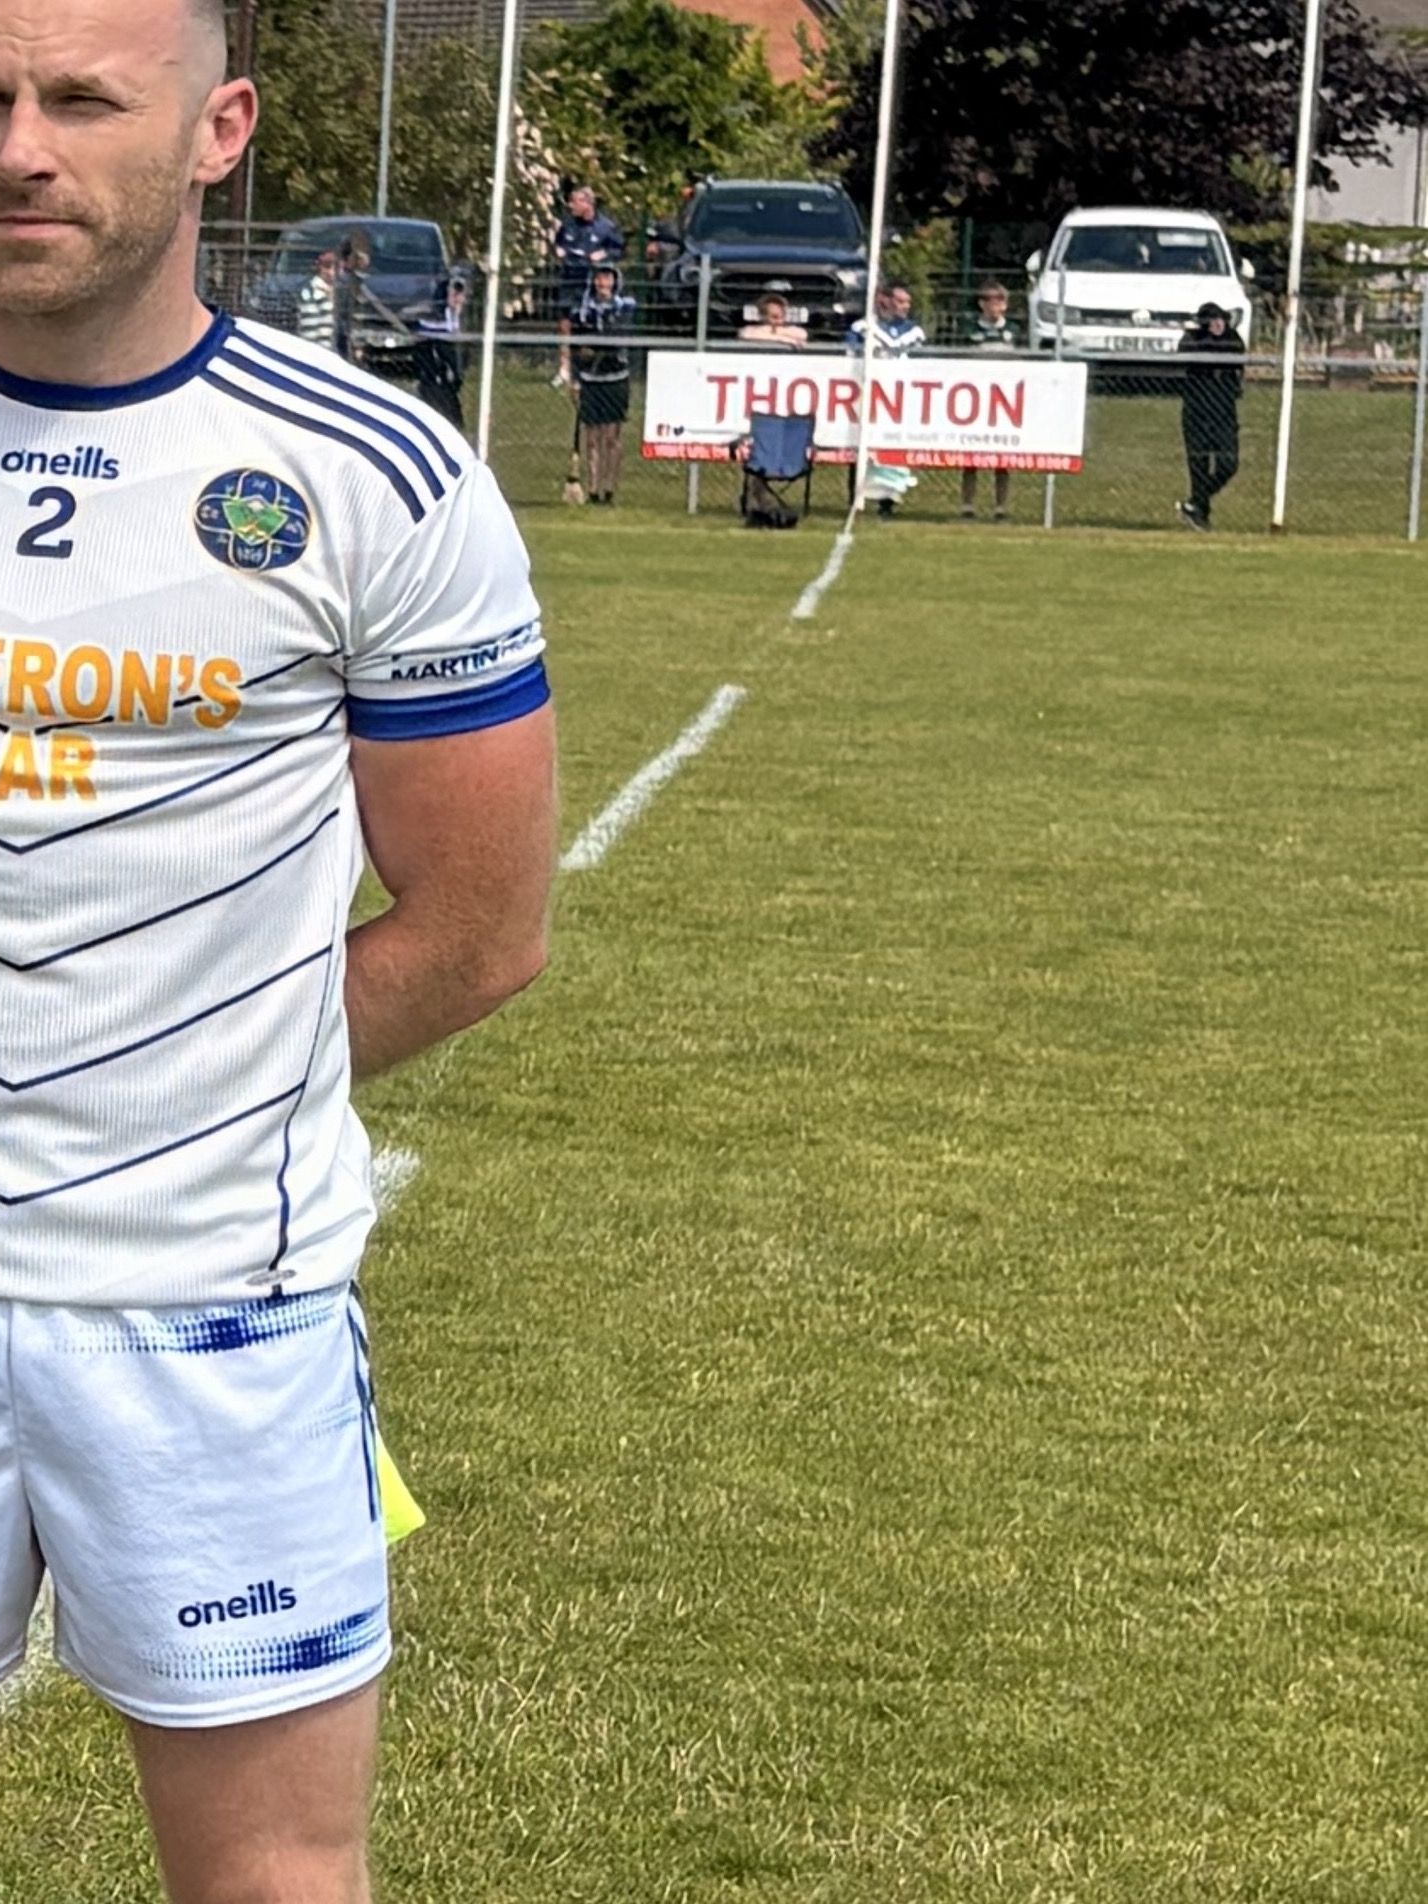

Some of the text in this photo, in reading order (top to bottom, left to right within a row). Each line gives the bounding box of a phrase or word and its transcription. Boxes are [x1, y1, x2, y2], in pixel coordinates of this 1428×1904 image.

[707, 375, 1025, 428] THORNTON
[16, 486, 77, 559] 2
[391, 645, 498, 680] MARTIN
